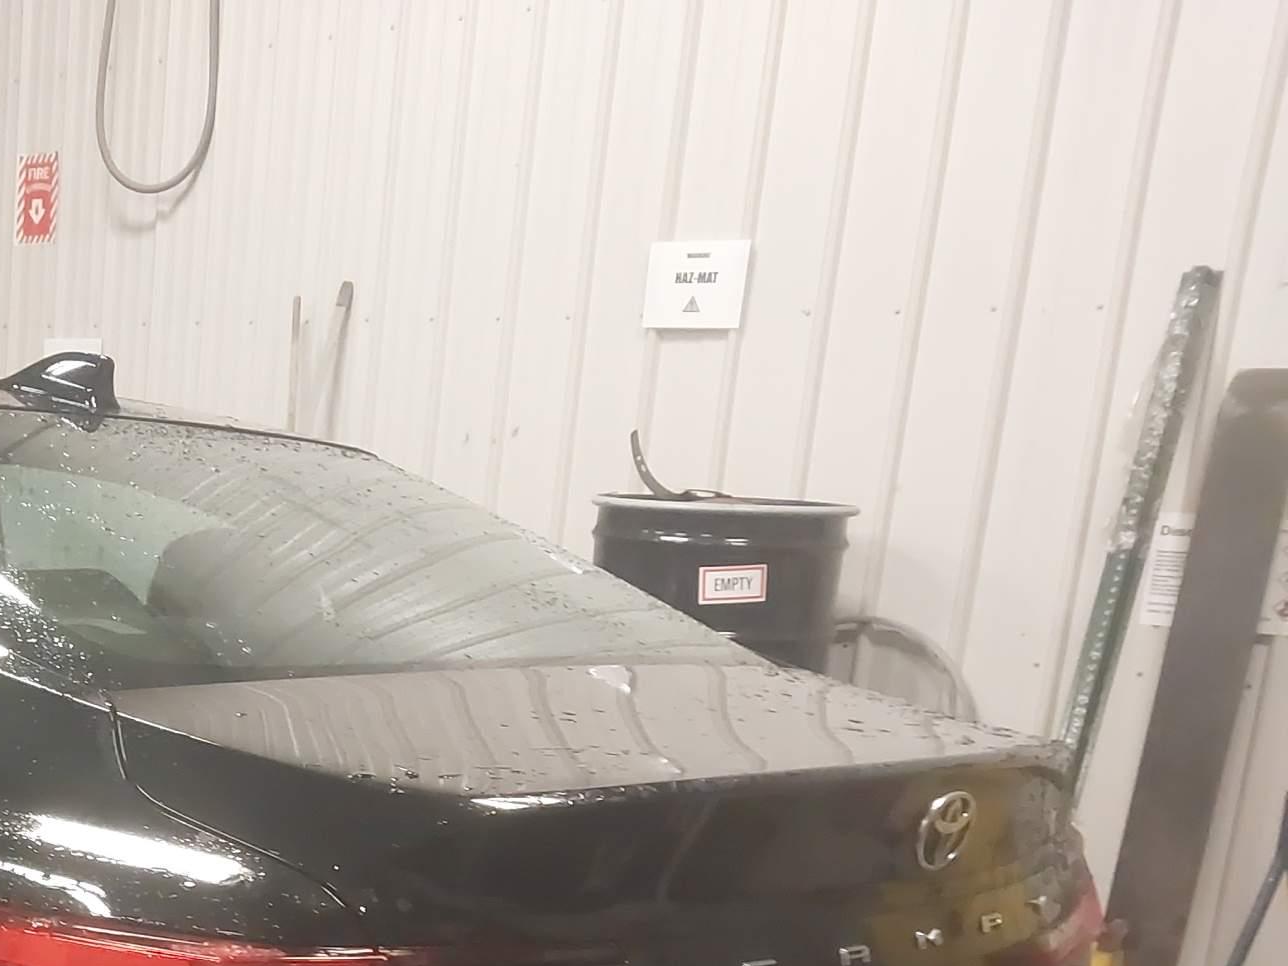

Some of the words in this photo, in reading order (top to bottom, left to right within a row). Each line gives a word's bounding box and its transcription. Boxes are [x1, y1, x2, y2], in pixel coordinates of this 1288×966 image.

[26, 166, 50, 180] FIRE
[675, 271, 719, 284] HAZ-MAT
[714, 576, 753, 592] EMPTY
